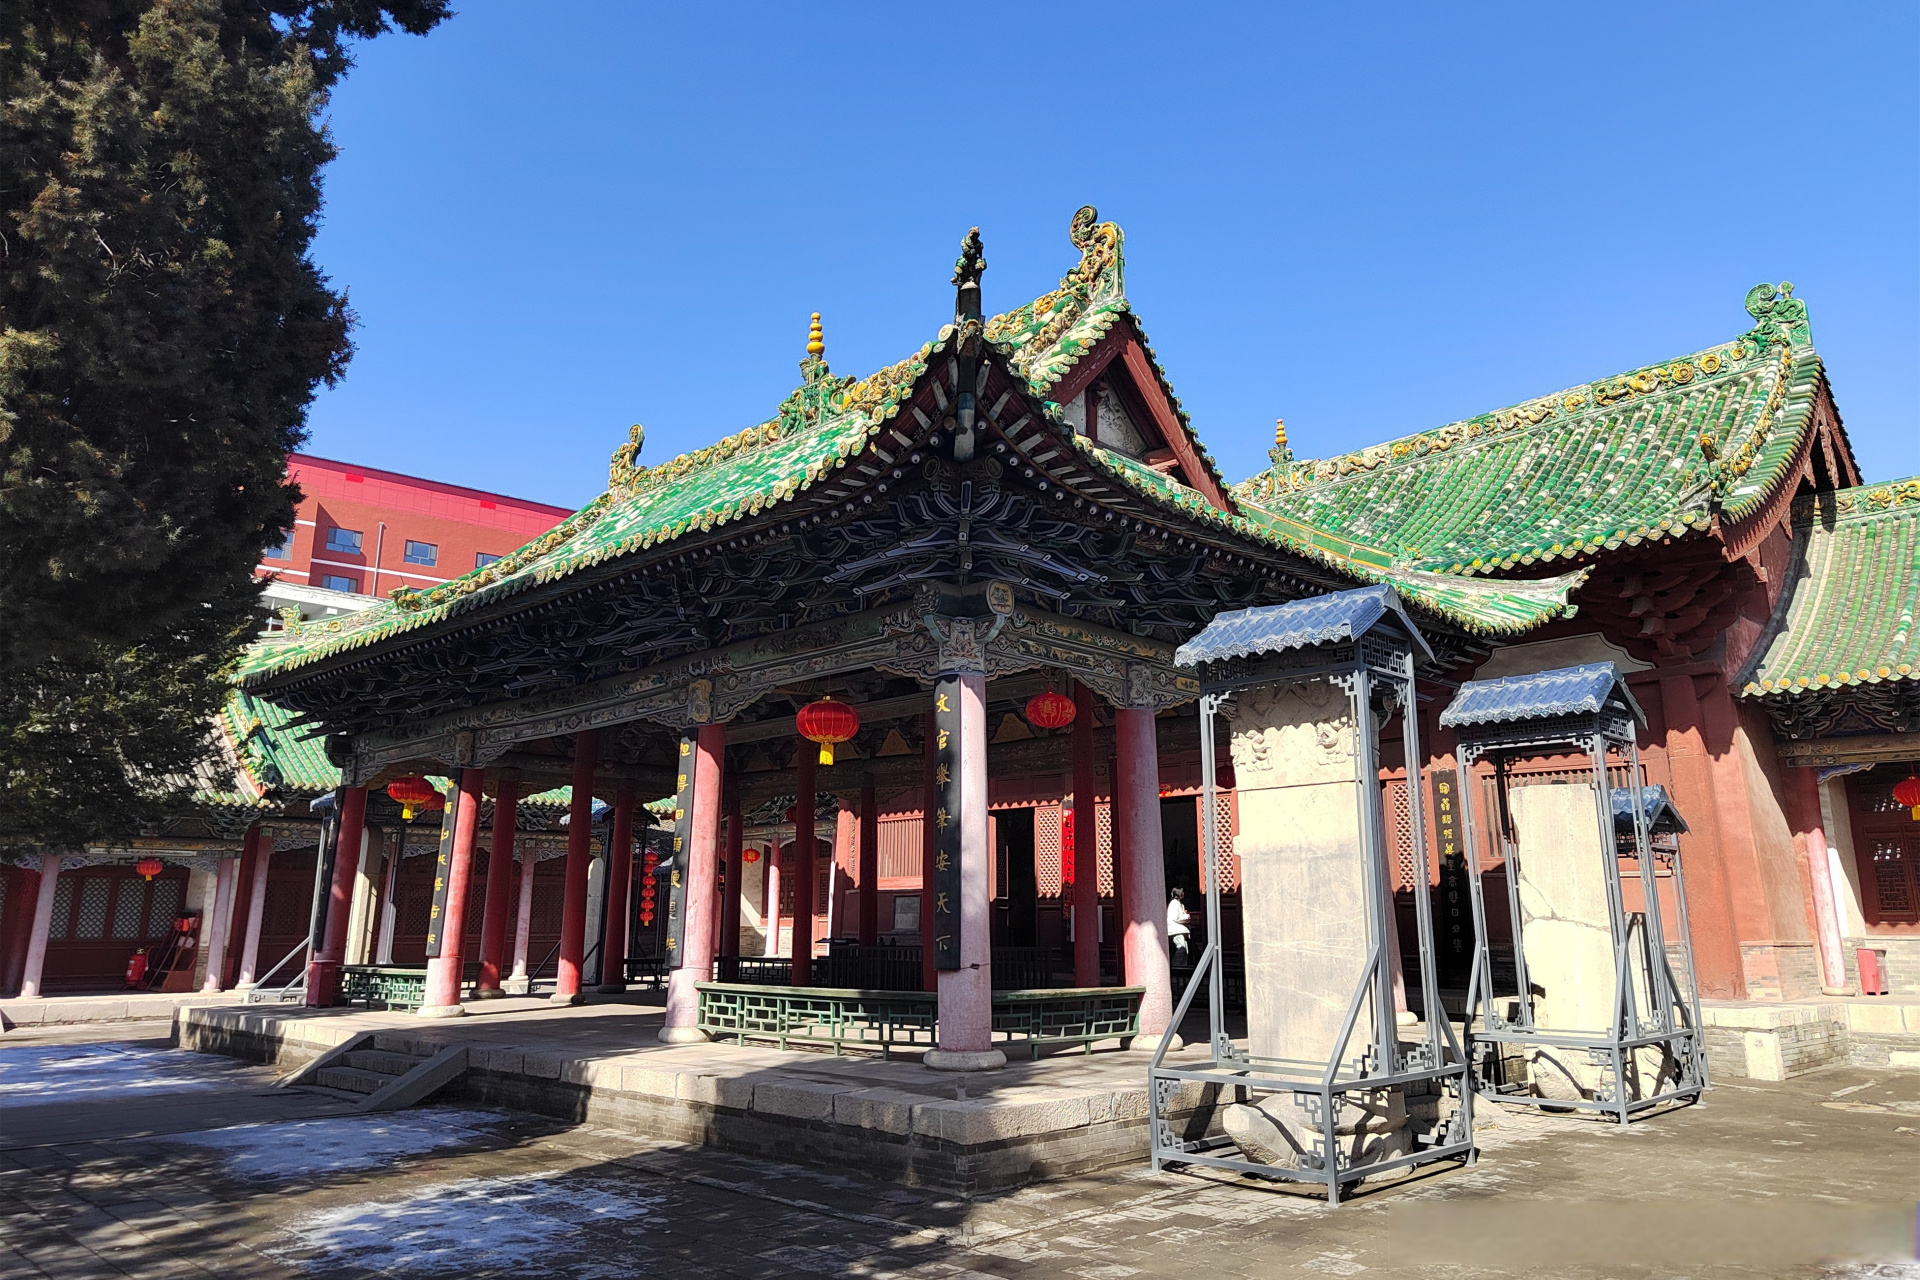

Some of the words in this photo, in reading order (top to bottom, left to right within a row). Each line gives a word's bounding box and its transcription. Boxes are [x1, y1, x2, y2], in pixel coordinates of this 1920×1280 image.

[935, 693, 952, 951] 文官舉筆安天下
